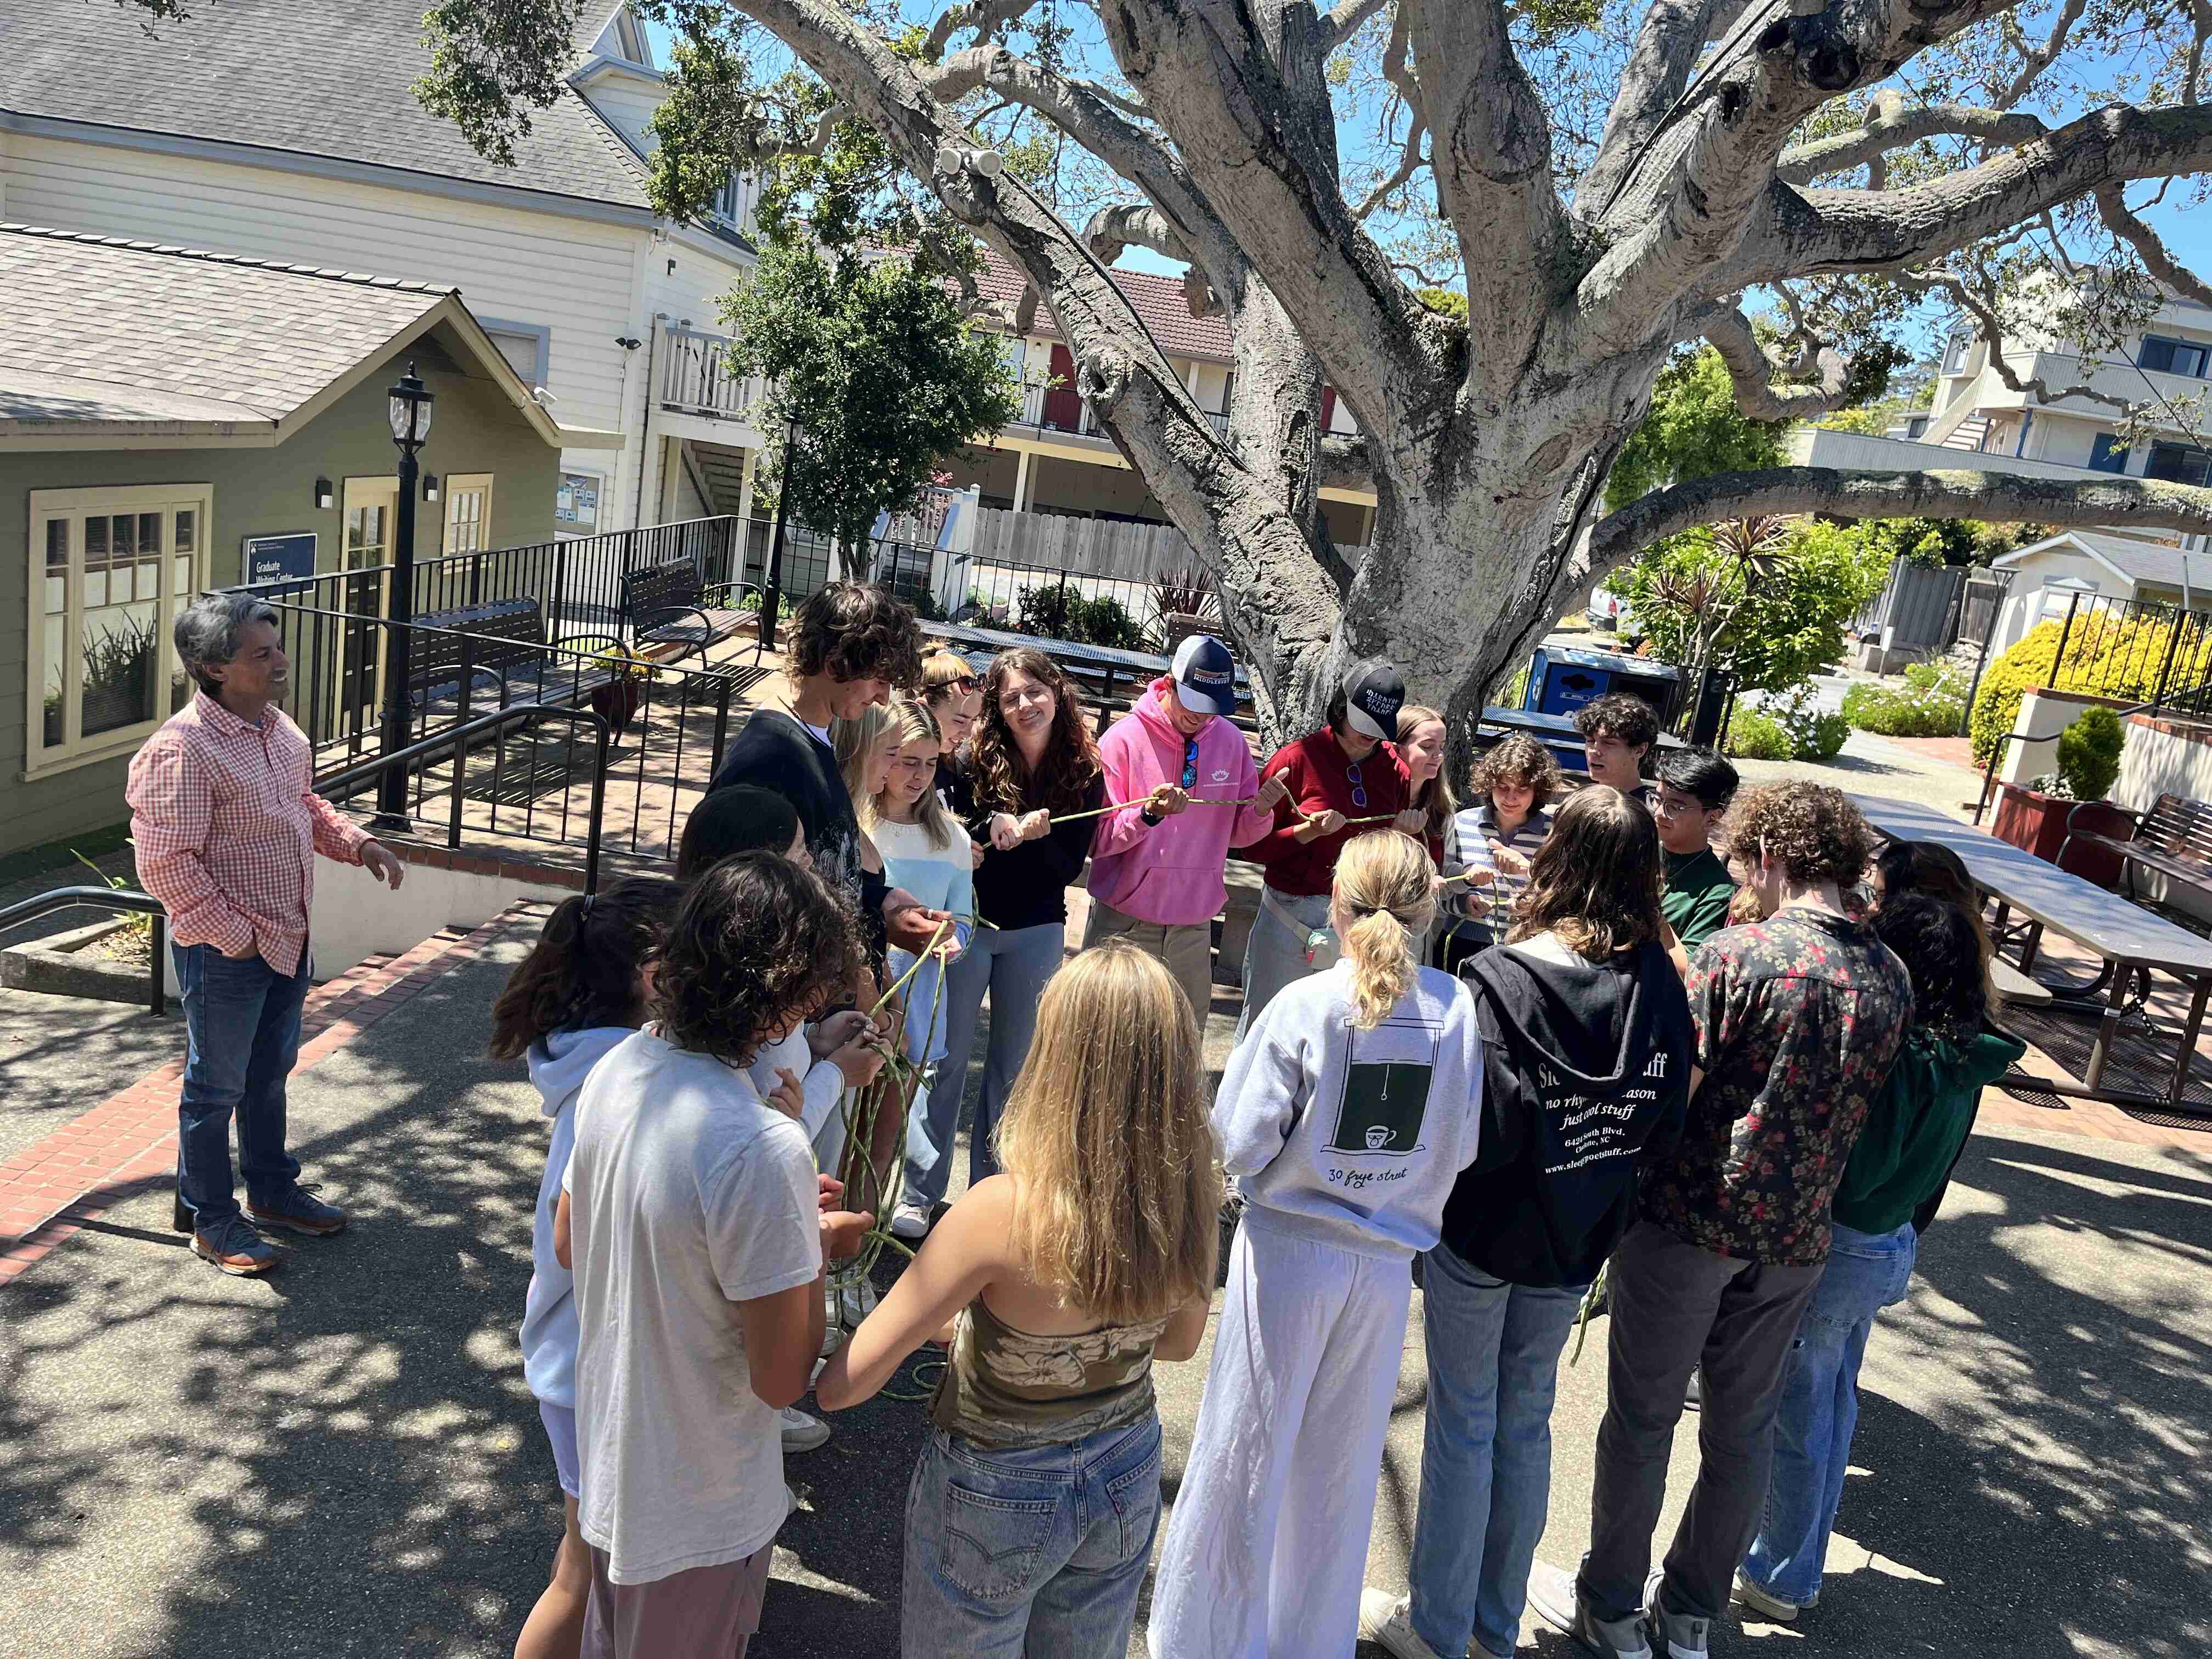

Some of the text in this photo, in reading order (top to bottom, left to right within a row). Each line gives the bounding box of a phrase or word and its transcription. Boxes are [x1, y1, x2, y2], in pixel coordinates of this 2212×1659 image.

[256, 560, 280, 573] Graduate
[1545, 1099, 1561, 1110] no
[1621, 1090, 1657, 1099] ason
[1559, 1112, 1584, 1130] just
[1600, 1104, 1637, 1120] stuff
[1602, 1127, 1626, 1136] Blvd.
[1329, 1169, 1343, 1181] 30
[1344, 1170, 1374, 1189] frye
